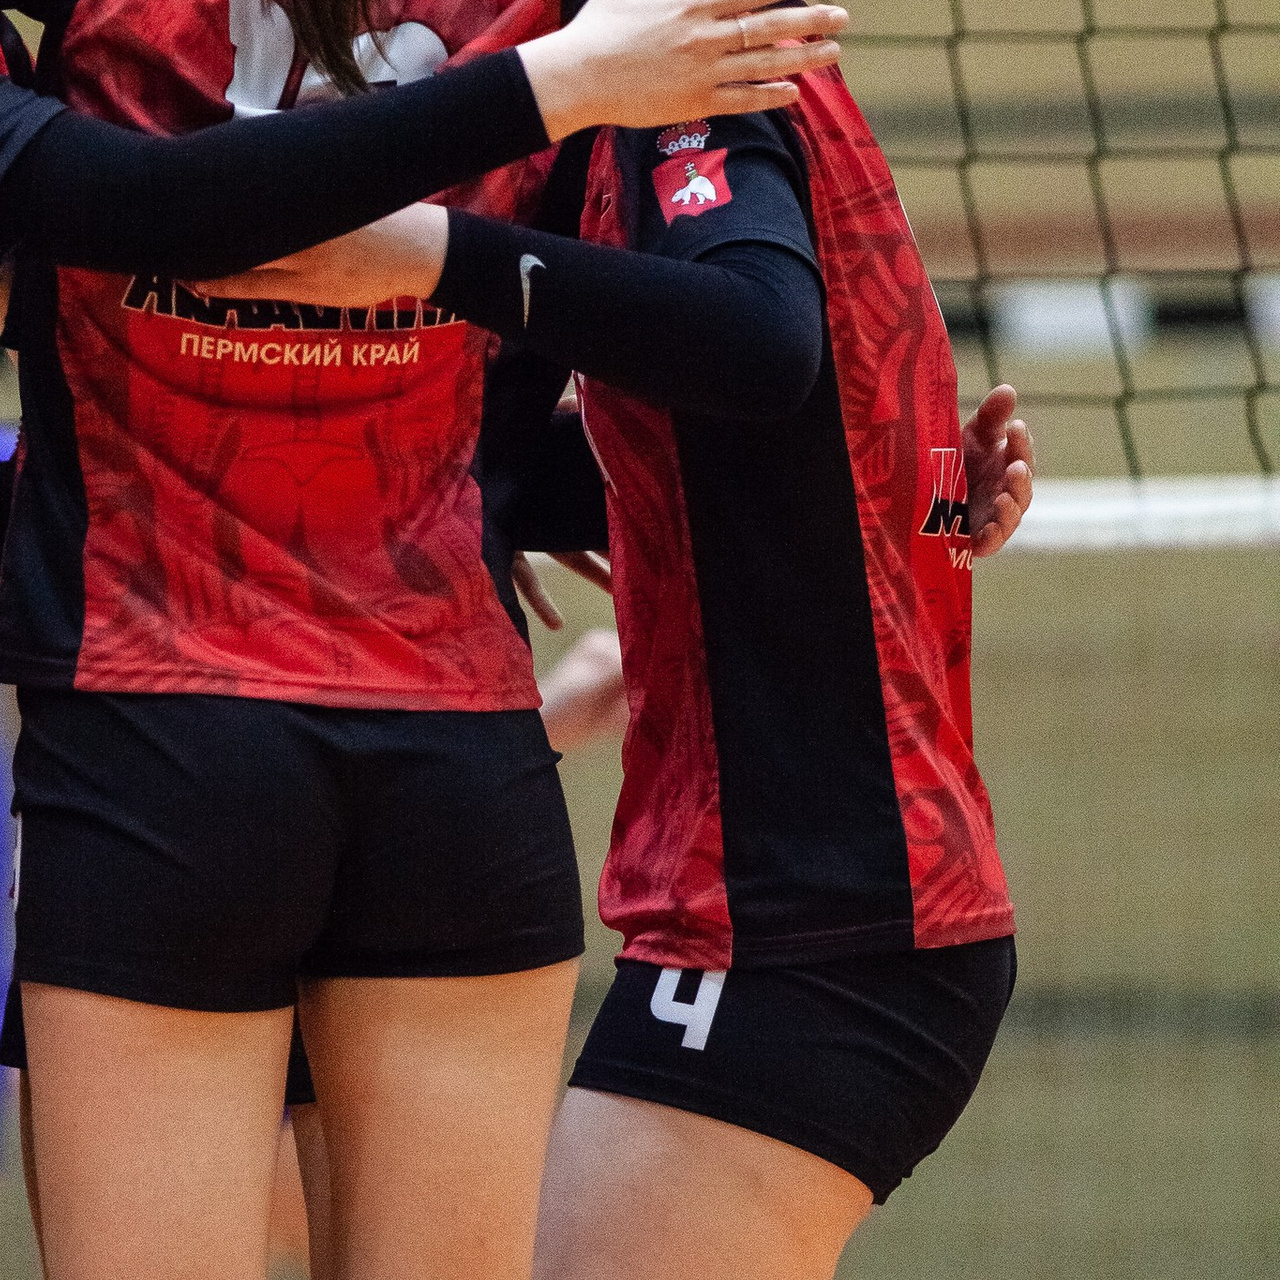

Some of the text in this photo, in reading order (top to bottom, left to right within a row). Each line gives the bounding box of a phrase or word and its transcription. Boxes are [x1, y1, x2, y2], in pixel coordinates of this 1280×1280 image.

[180, 332, 420, 368] ПЕРМСКИЙ КРАЙ
[650, 968, 727, 1051] 4
